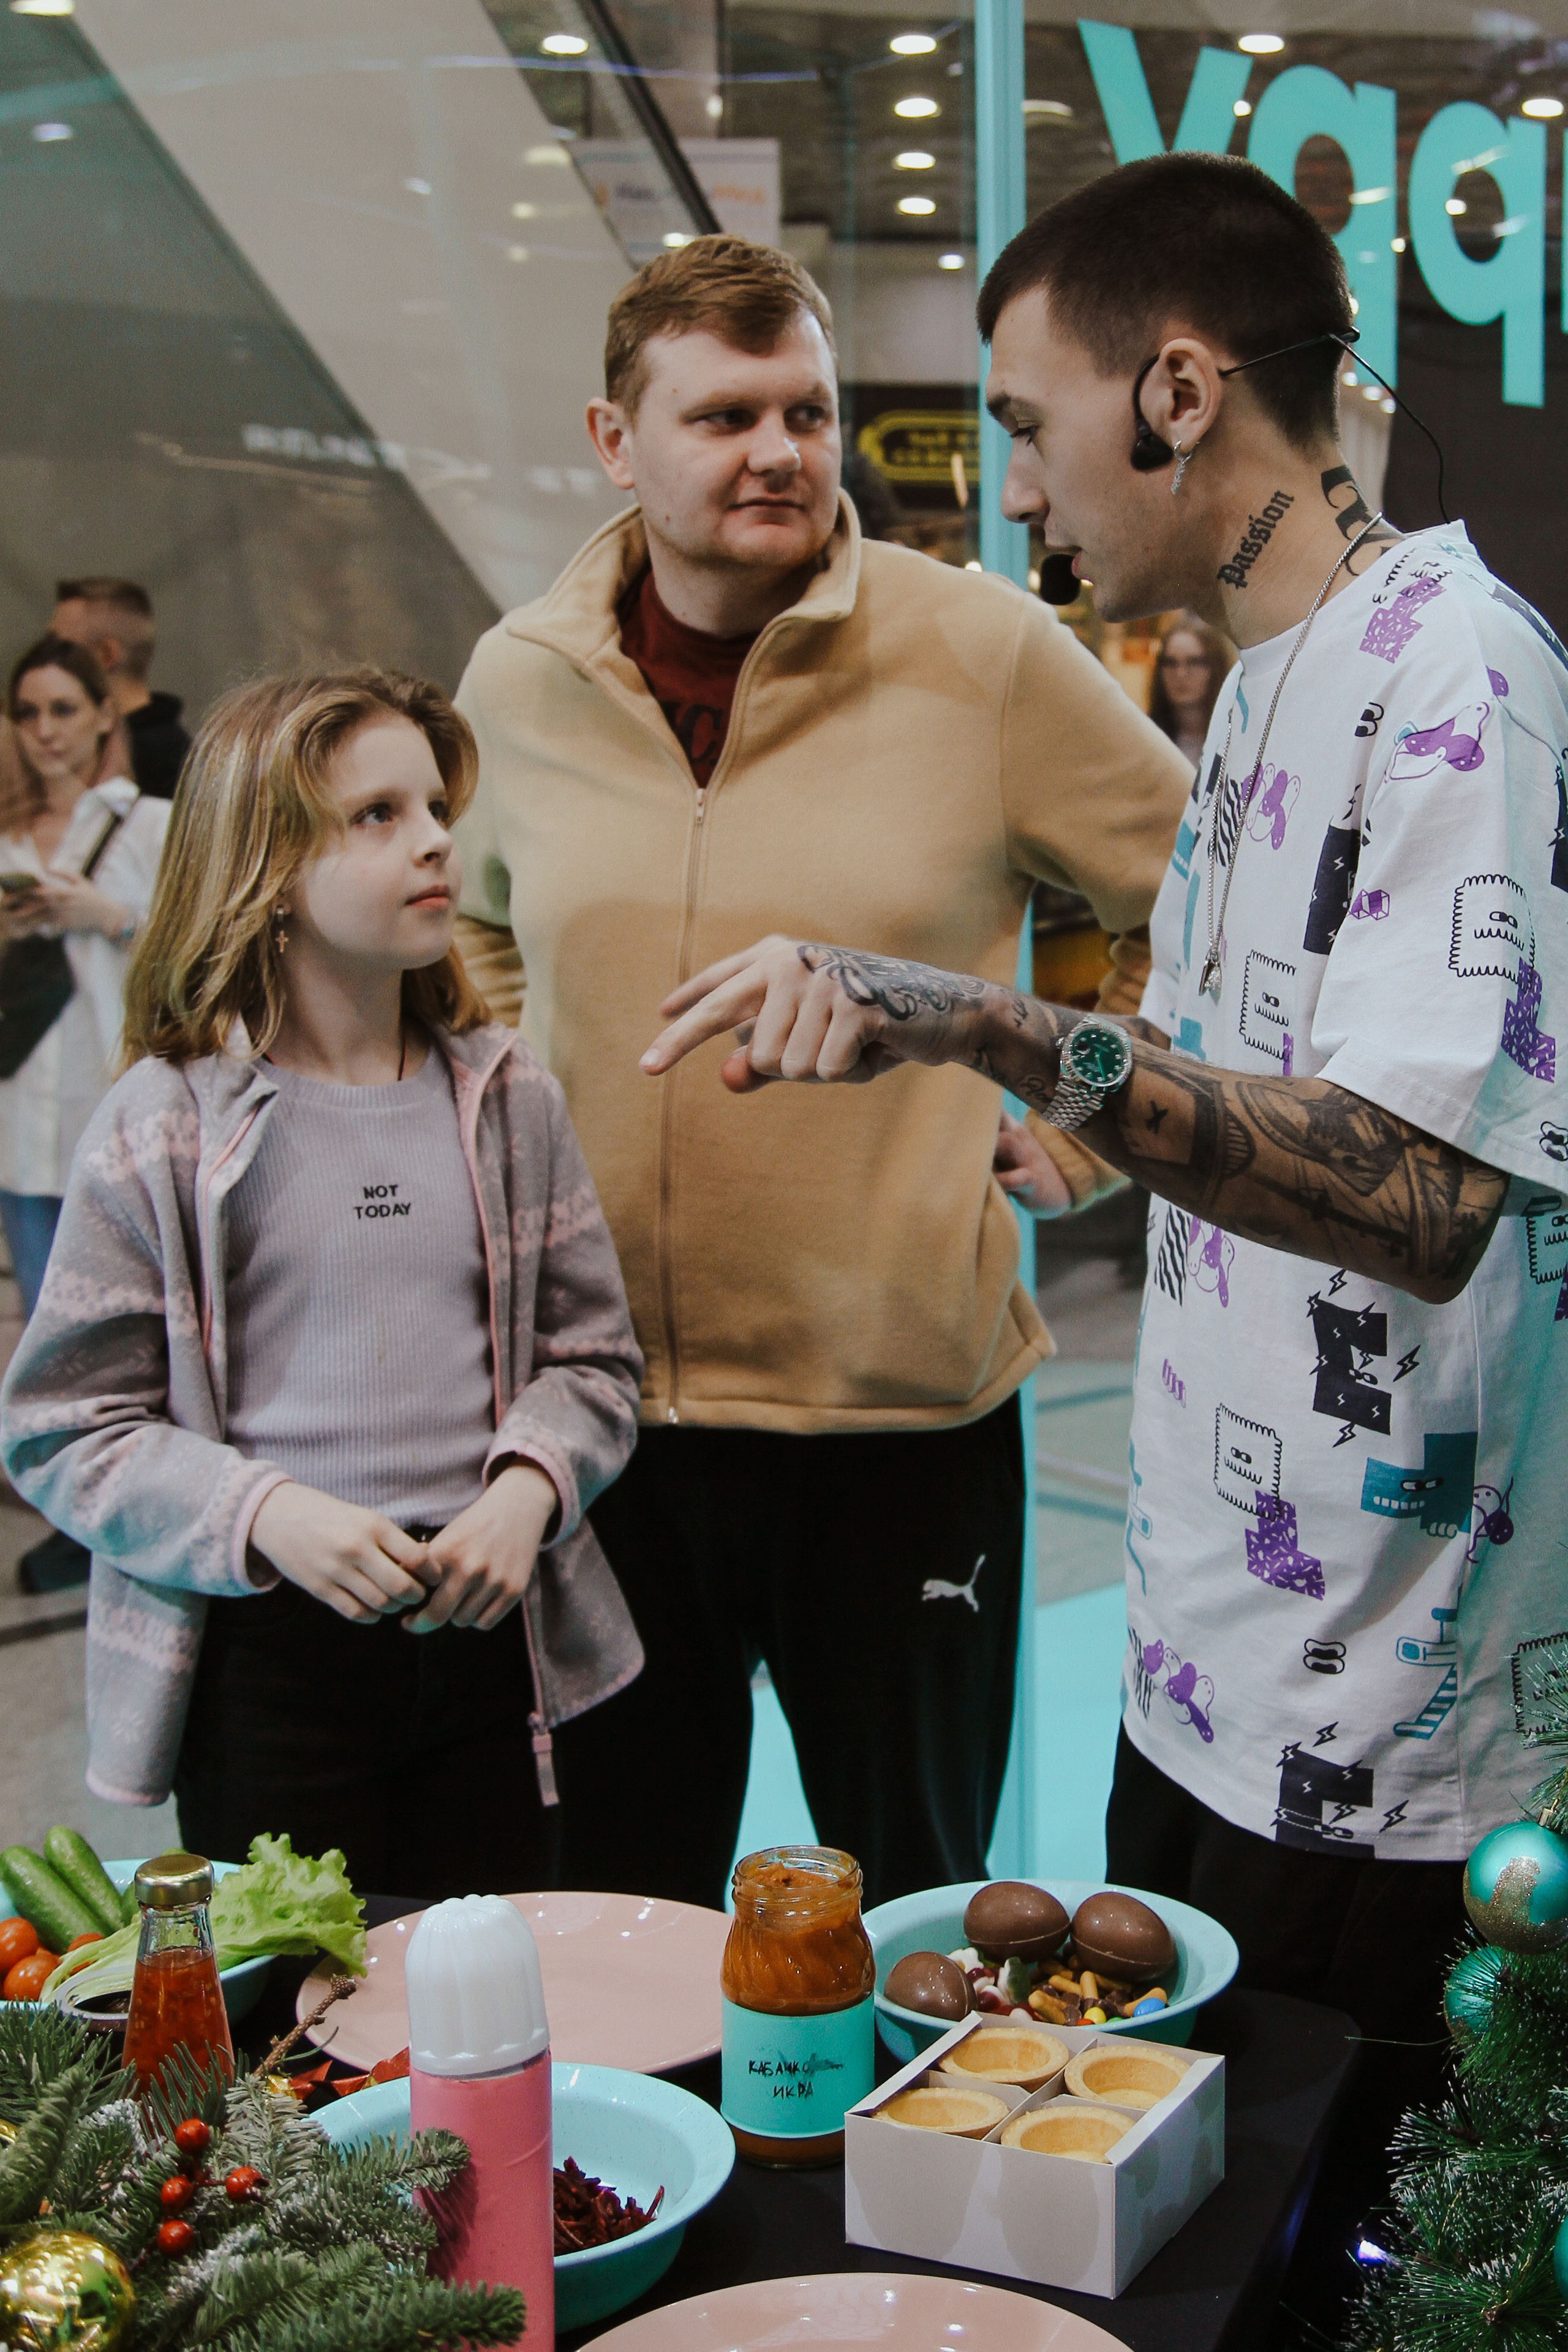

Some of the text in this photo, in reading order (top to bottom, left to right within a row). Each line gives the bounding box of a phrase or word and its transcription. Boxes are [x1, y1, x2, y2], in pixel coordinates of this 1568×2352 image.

[363, 1184, 398, 1199] NOT
[353, 1202, 411, 1219] TODAY
[773, 2081, 813, 2100] ИКРА
